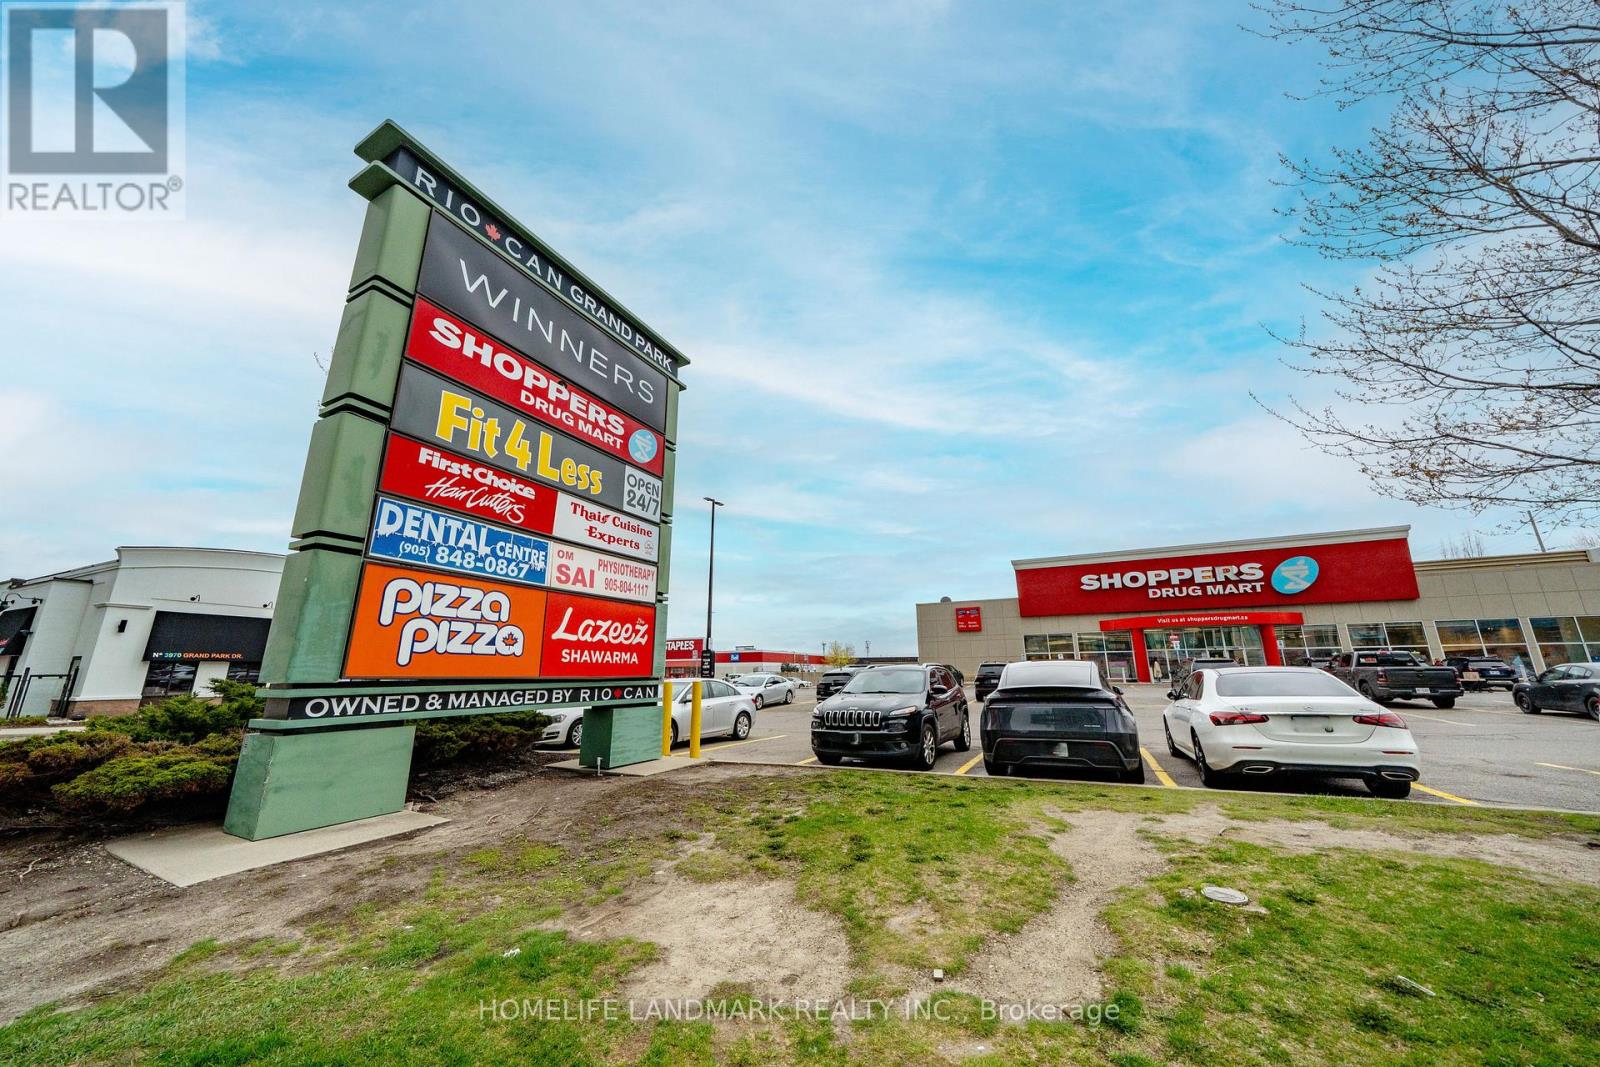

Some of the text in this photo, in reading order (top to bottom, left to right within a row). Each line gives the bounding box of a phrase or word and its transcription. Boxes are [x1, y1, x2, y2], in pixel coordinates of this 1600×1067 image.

[459, 258, 654, 404] WINNERS
[570, 285, 632, 341] GRAND
[635, 330, 672, 372] PARK
[429, 317, 625, 435] SHOPPERS
[520, 389, 623, 449] DRUG MART
[435, 390, 602, 495] Fit 4 Less
[418, 447, 536, 500] First Choice
[626, 473, 660, 498] OPEN
[425, 476, 474, 501] Hair
[626, 489, 660, 516] 24/7
[377, 502, 546, 564] DENTAL CENTRE
[586, 525, 640, 550] Experts
[612, 516, 653, 537] Cuisine
[399, 541, 431, 557] (905)
[435, 546, 530, 578] 848-0867
[557, 549, 574, 560] OM
[555, 563, 595, 589] SAI
[598, 559, 655, 582] PHYSIOTHERAPY
[1080, 562, 1265, 591] SHOPPERS
[604, 578, 649, 596] 905-804-1117
[1148, 581, 1265, 599] DRUG MART
[551, 607, 649, 646] Lazeez
[1187, 615, 1248, 623] shoppersdrugmart.ca
[561, 649, 639, 664] SHAWARMA
[305, 686, 655, 718] OWNED & MANAGED BY RIO CAN
